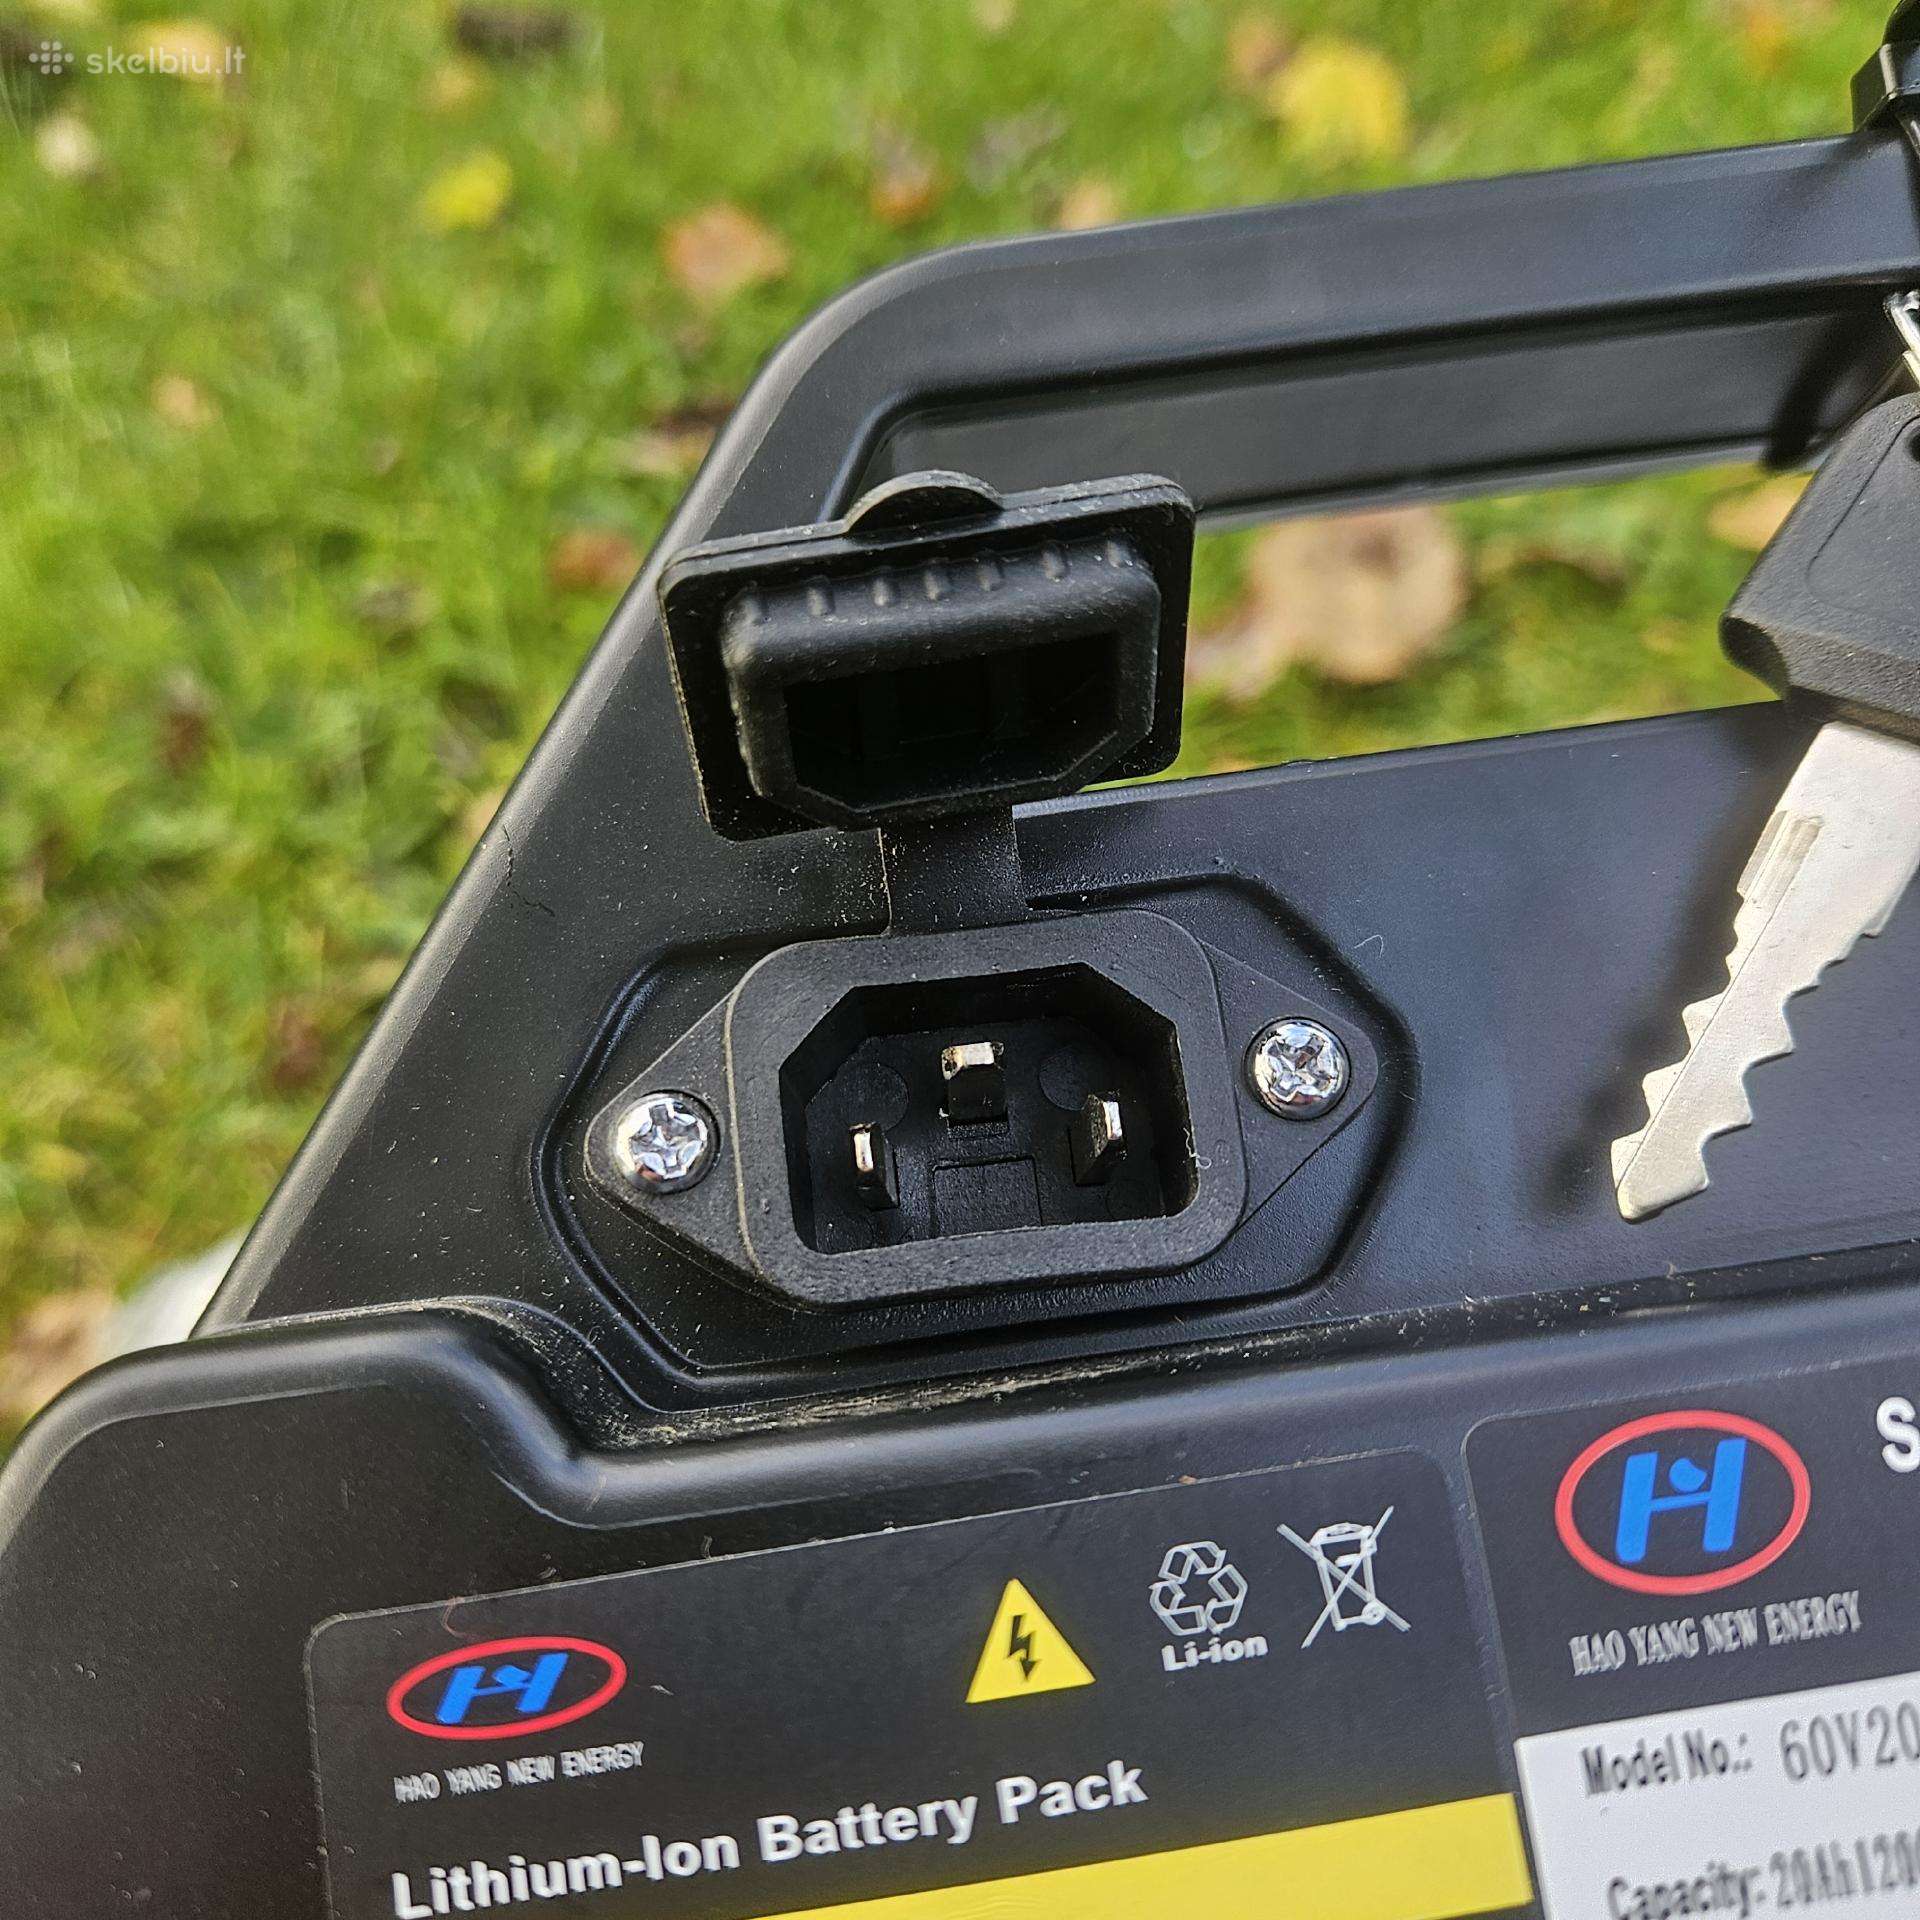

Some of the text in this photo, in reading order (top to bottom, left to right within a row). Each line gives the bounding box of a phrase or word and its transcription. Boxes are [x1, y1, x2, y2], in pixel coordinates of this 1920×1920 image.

[1876, 1396, 1920, 1473] S
[1161, 1636, 1269, 1672] Li-ion
[1568, 1591, 1862, 1676] HAO YANG NEW ENERGY
[393, 1740, 645, 1803] HAO YANG NEW ENERGY
[1581, 1733, 1681, 1798] Model
[391, 1760, 1149, 1920] Lithium-Ion Battery Pack
